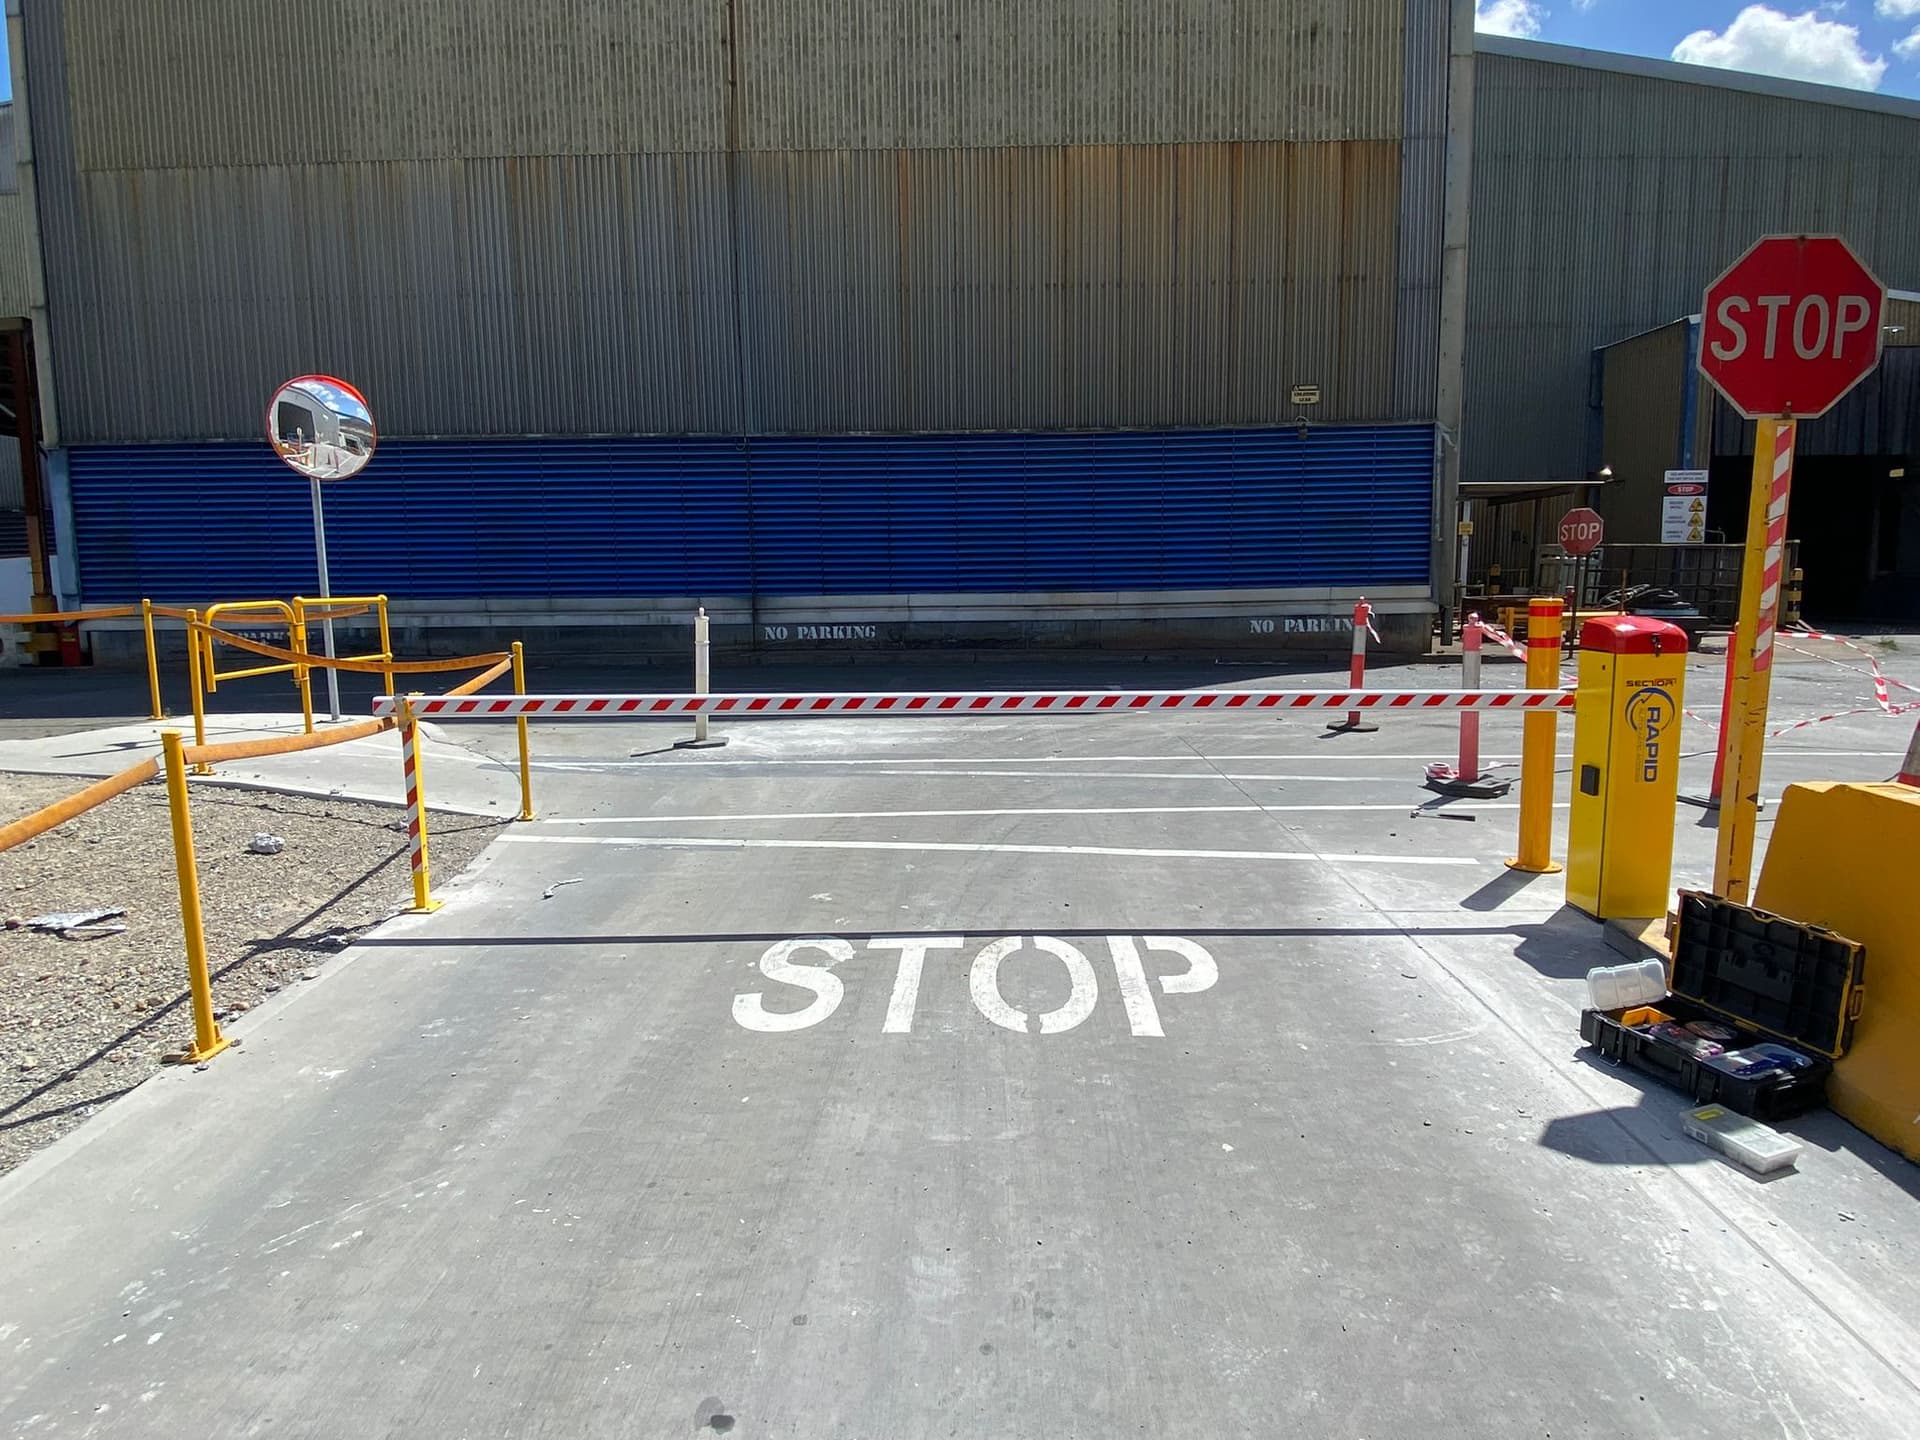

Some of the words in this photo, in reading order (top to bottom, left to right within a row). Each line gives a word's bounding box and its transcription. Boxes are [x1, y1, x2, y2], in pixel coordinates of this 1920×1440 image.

[1711, 294, 1871, 361] STOP
[1561, 522, 1600, 541] STOP
[764, 626, 788, 640] NO
[797, 625, 876, 639] PARKING
[1250, 619, 1275, 633] NO
[1284, 618, 1354, 633] PARKIN
[1643, 706, 1661, 782] RAPID
[731, 935, 1219, 1037] STOP
